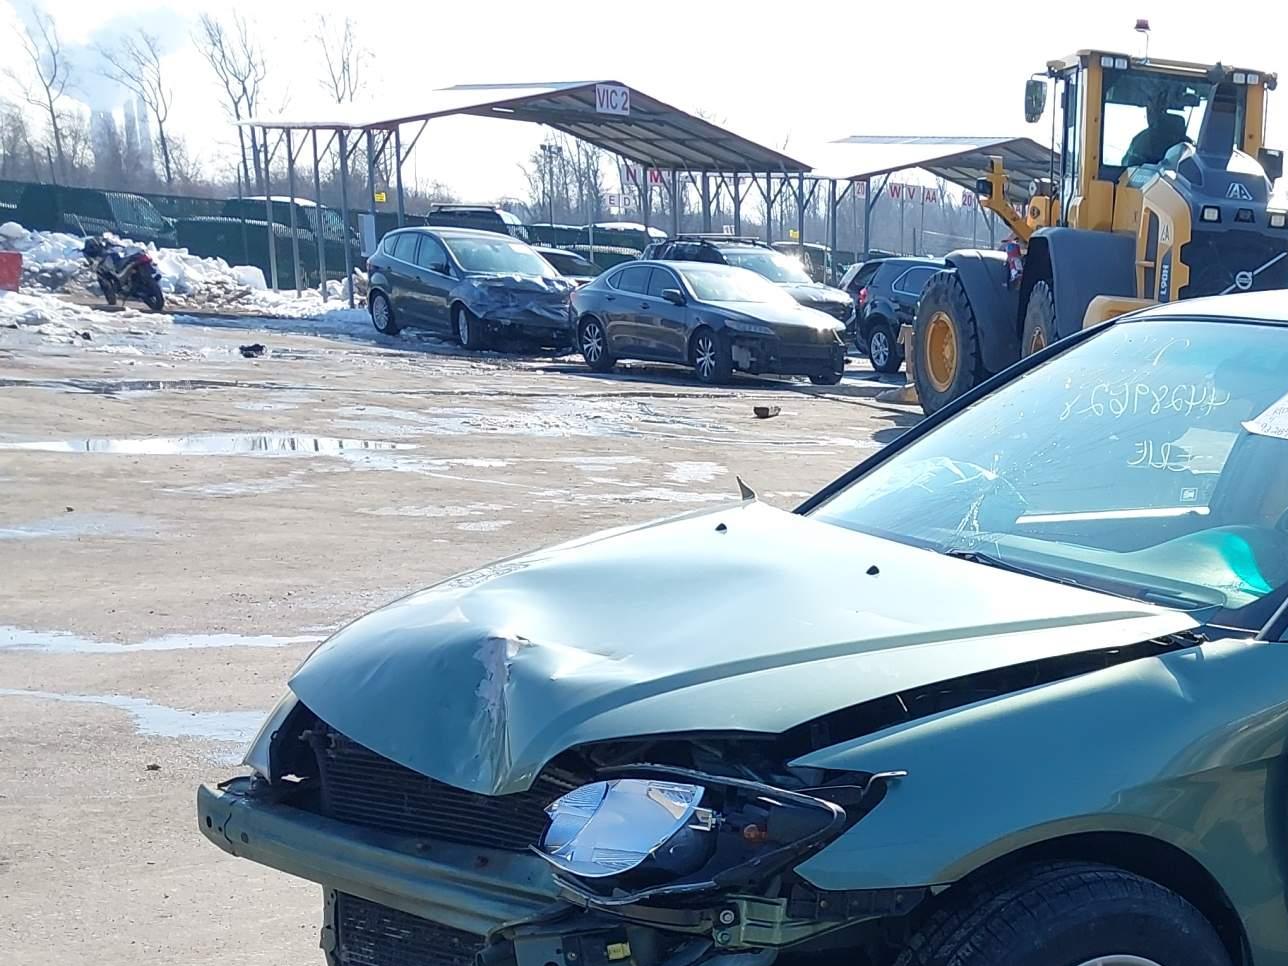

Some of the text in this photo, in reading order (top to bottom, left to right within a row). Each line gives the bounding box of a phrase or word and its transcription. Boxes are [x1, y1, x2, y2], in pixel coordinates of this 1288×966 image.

[596, 87, 629, 111] VIC 2
[890, 185, 901, 198] W
[907, 187, 916, 200] V
[962, 194, 973, 207] 20
[1160, 264, 1170, 296] L90H
